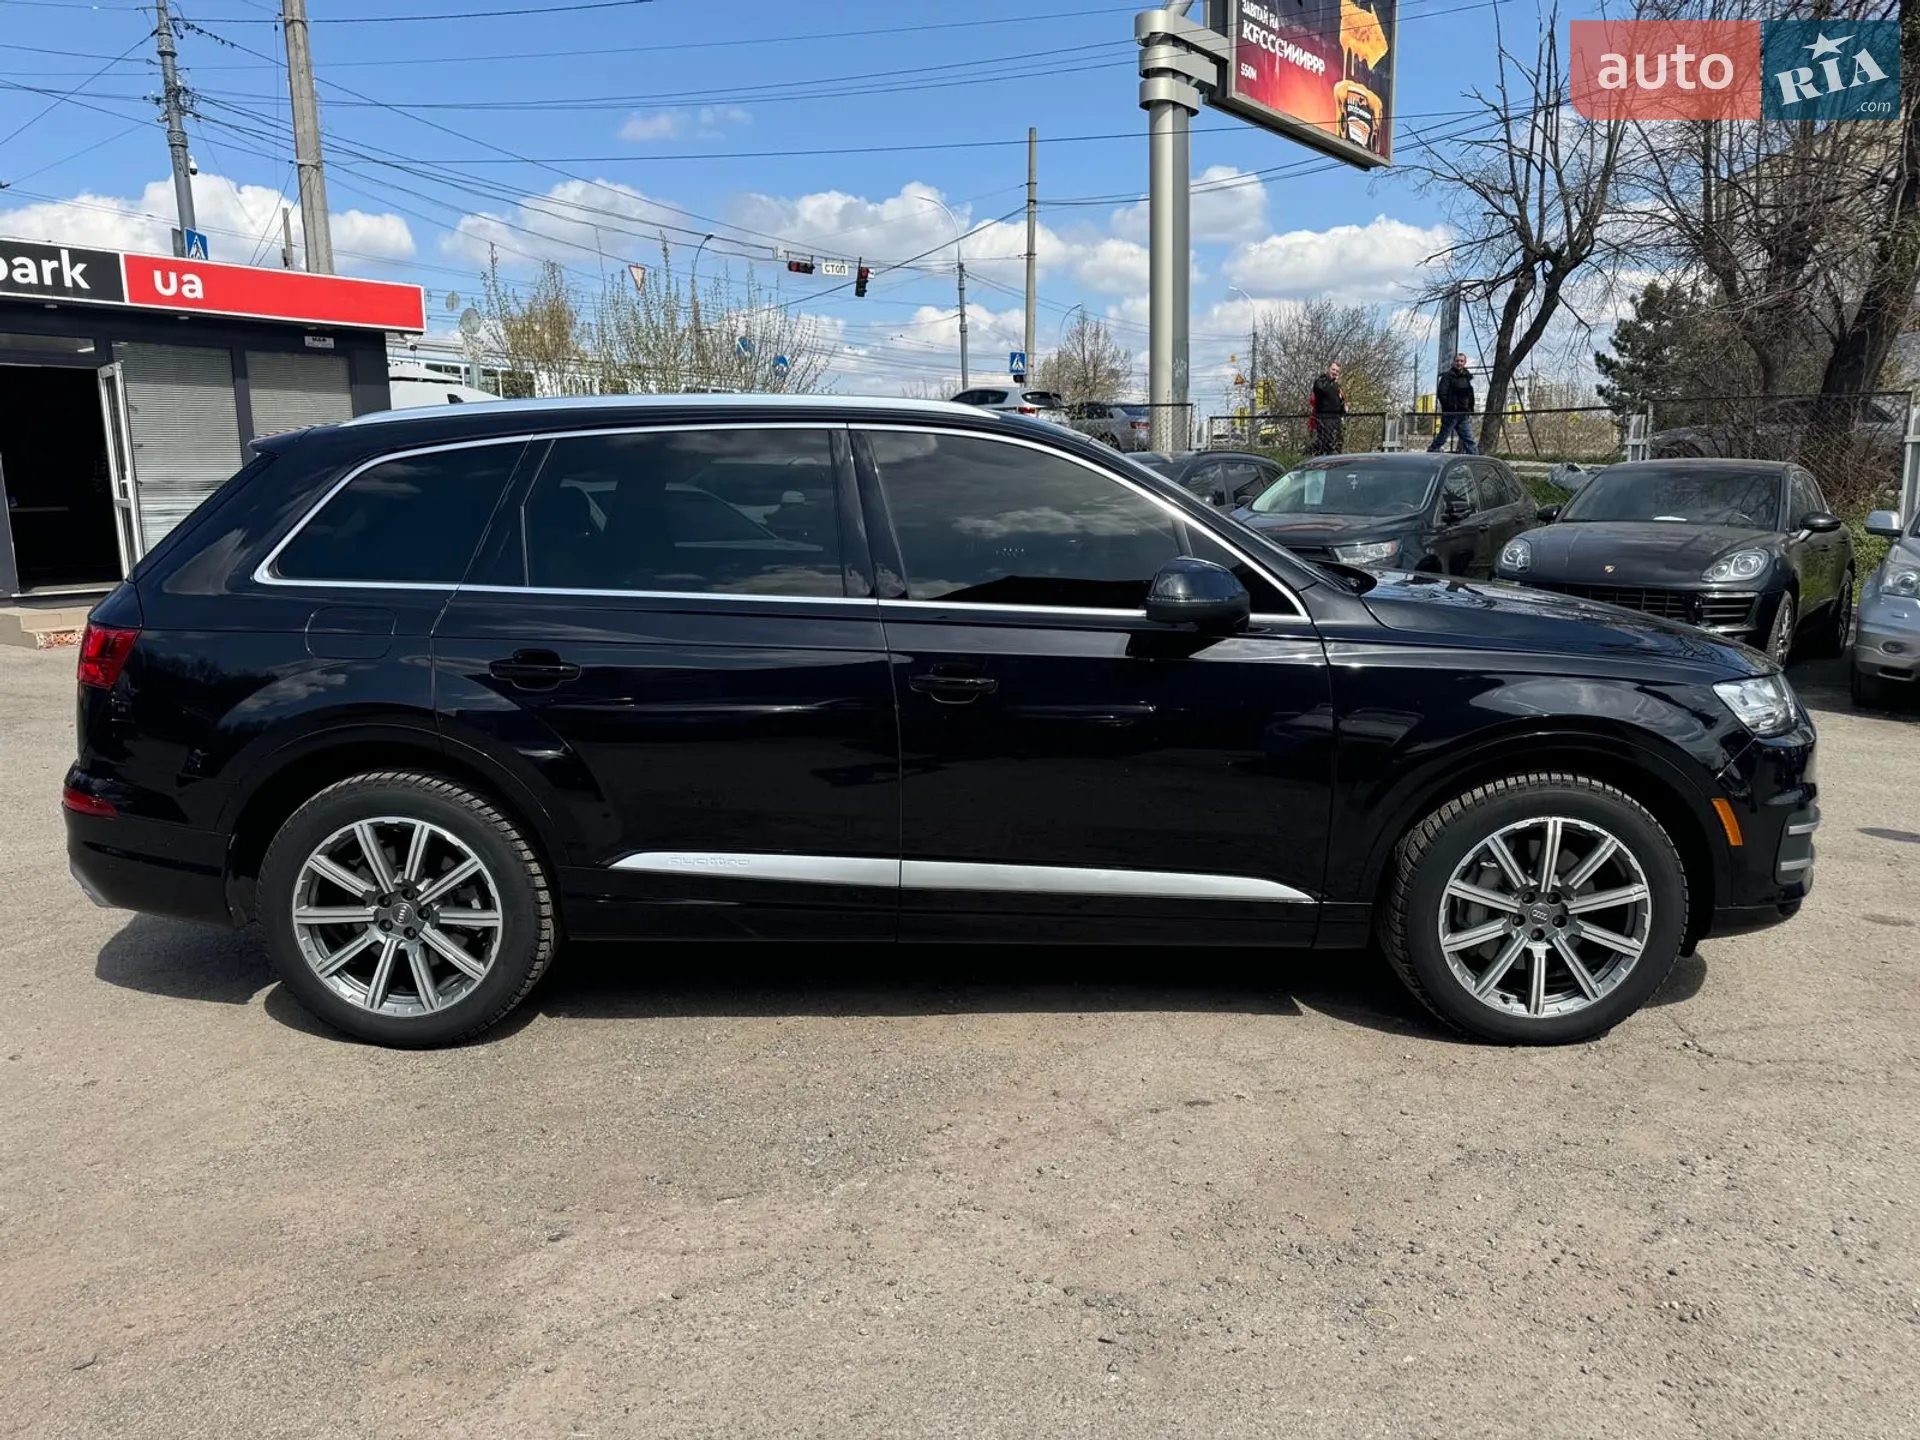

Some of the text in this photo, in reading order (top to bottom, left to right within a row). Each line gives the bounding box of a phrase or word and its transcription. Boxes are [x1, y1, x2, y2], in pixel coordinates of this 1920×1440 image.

[1269, 13, 1280, 31] НА
[824, 263, 846, 274] СТОП
[153, 269, 205, 299] ua
